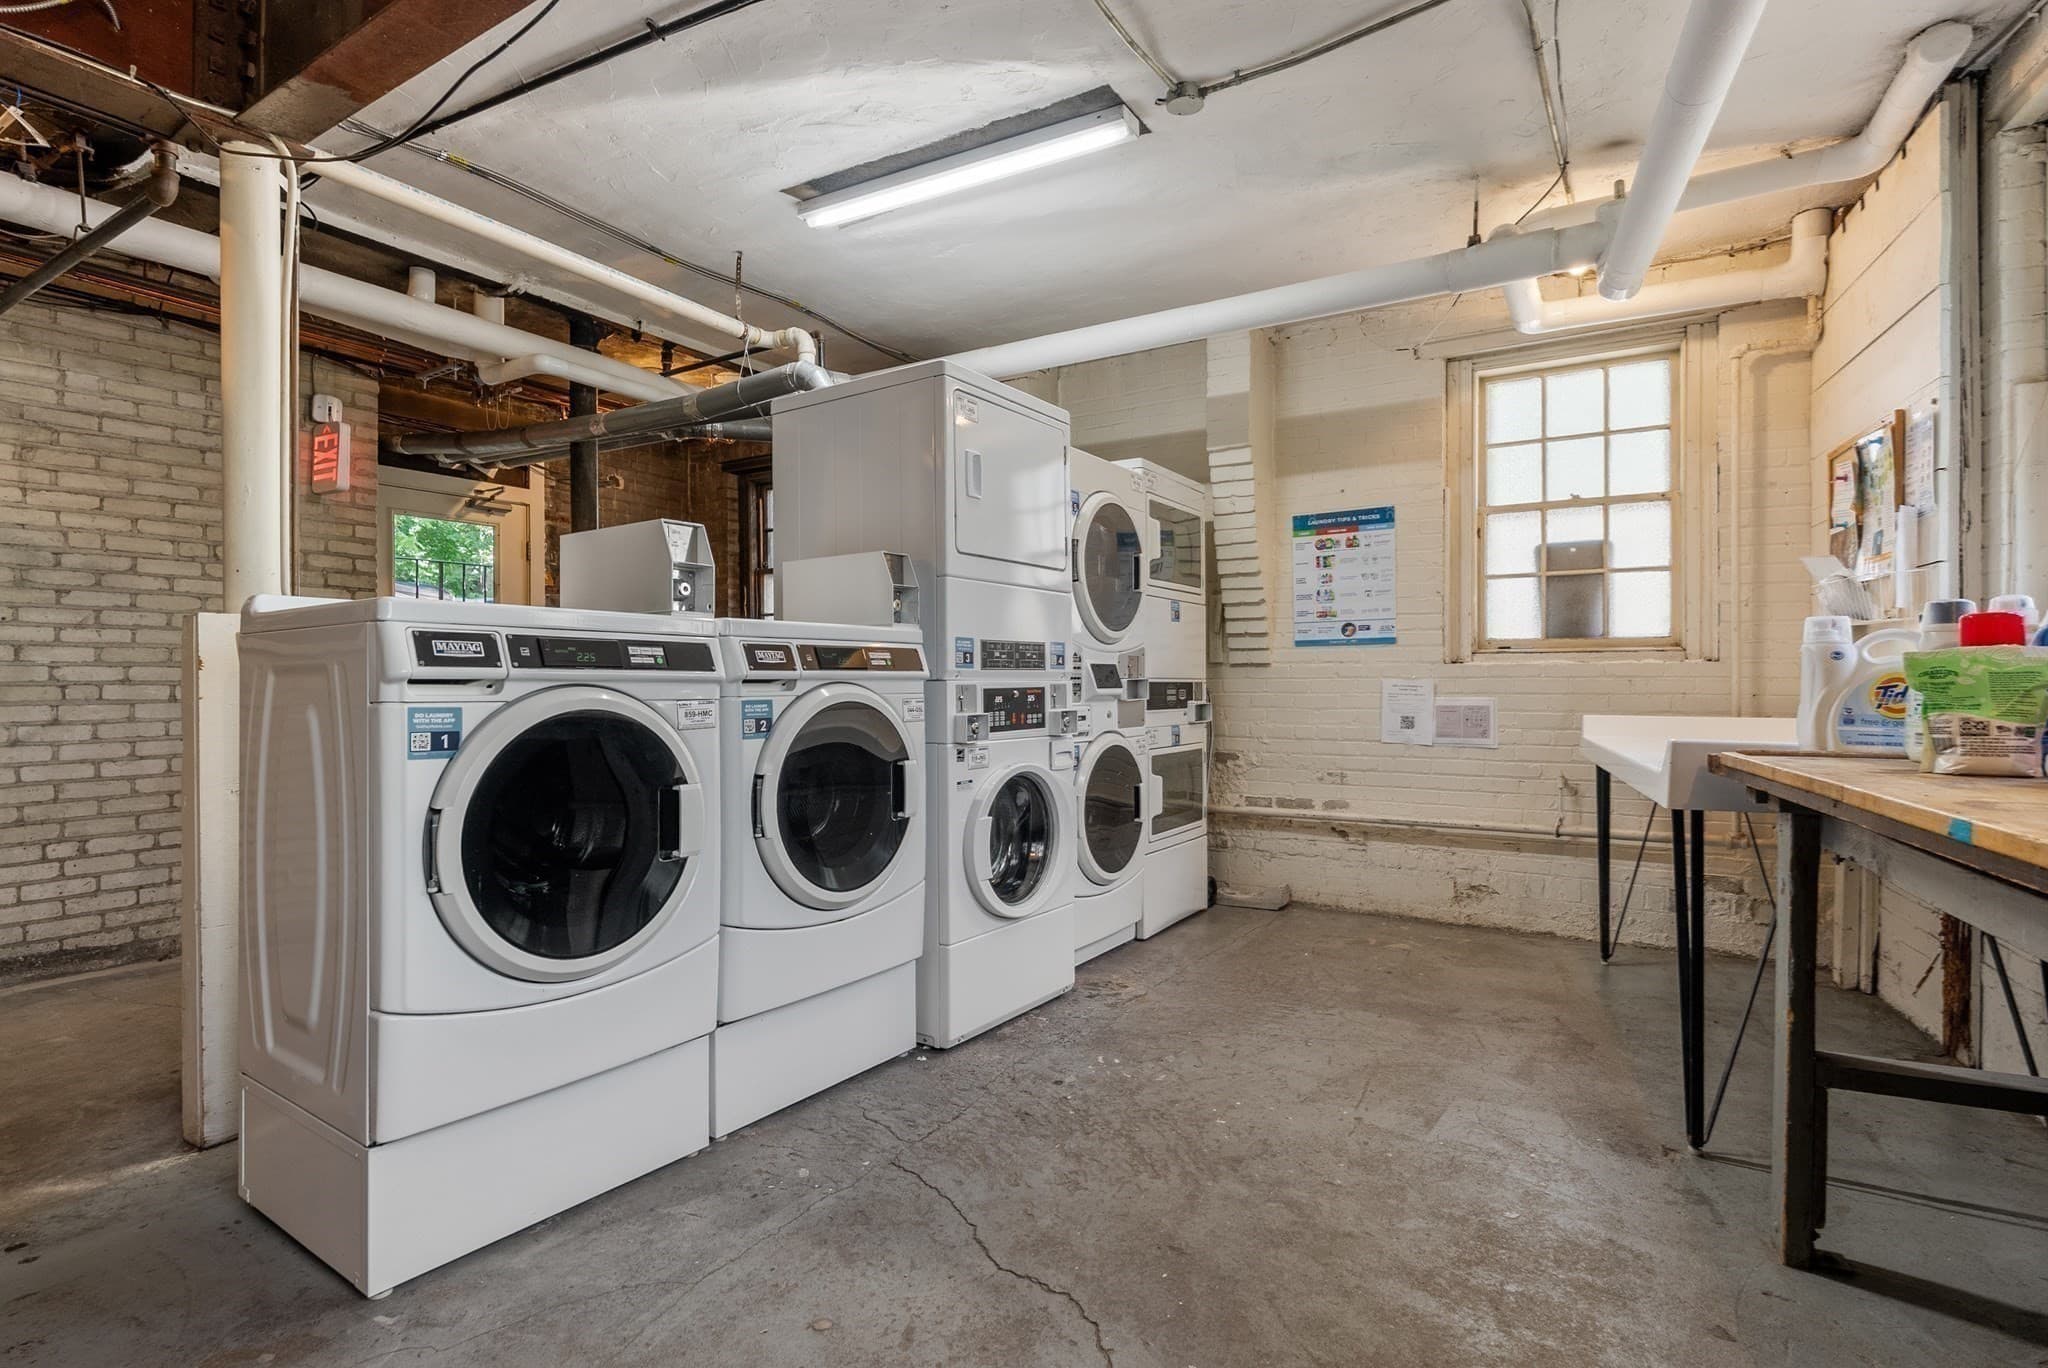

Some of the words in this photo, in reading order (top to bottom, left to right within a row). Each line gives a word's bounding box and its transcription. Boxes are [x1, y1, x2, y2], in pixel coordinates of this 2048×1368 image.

[313, 433, 338, 481] EXIT
[1308, 518, 1336, 526] LAUNDRY
[436, 642, 481, 652] MAYTAG
[1876, 684, 1909, 709] Tid
[760, 720, 767, 732] 2
[441, 734, 449, 749] 1
